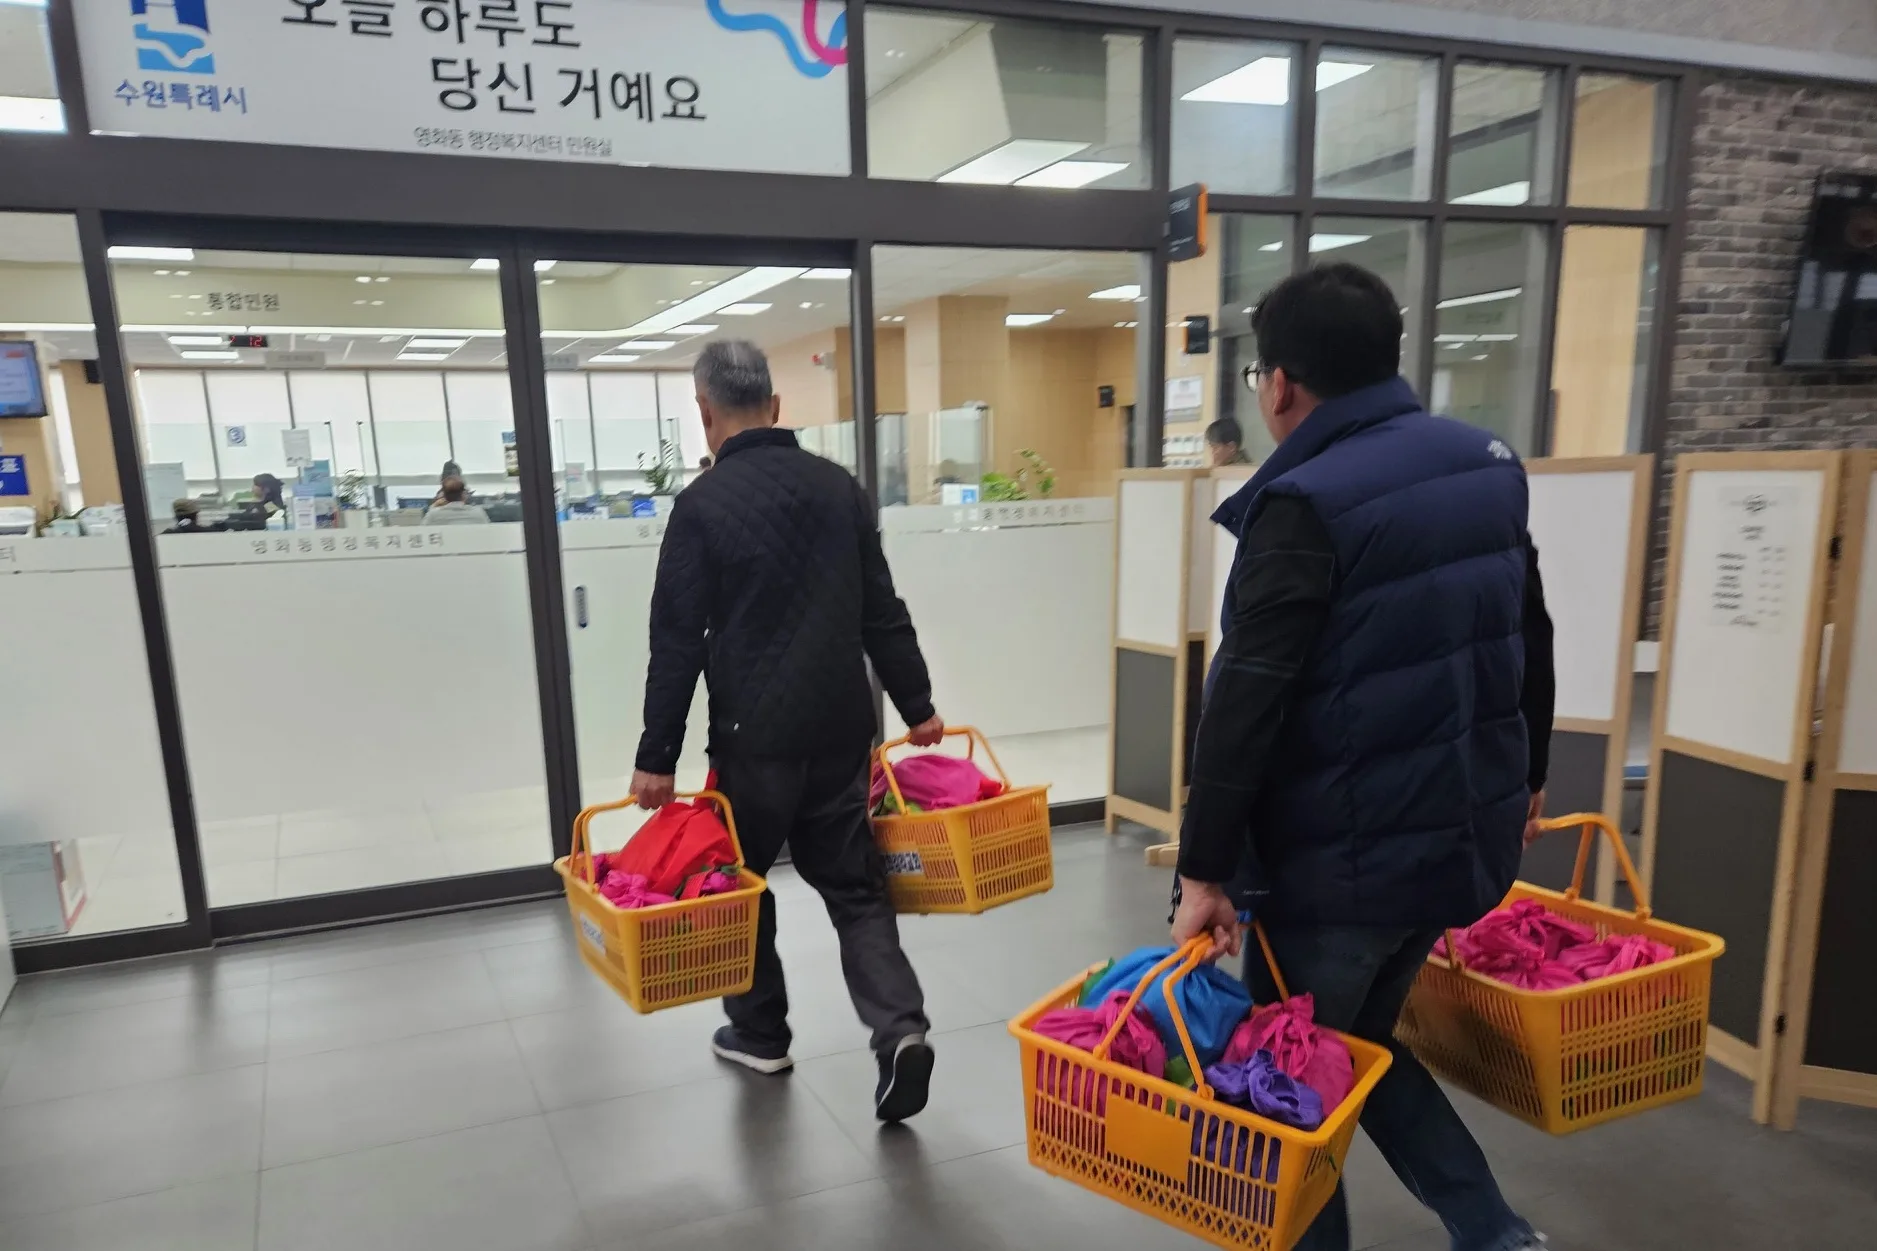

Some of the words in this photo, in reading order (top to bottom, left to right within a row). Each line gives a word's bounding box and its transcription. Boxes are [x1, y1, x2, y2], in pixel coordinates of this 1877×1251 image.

[415, 0, 582, 48] 하루도
[114, 78, 249, 115] 수원특례시
[430, 56, 536, 115] 당신
[557, 67, 707, 122] 거예요
[413, 126, 465, 149] 영화동
[467, 129, 563, 154] 행정복지센터
[207, 291, 281, 312] 통합민원
[251, 532, 445, 556] 영화동행정복지센터
